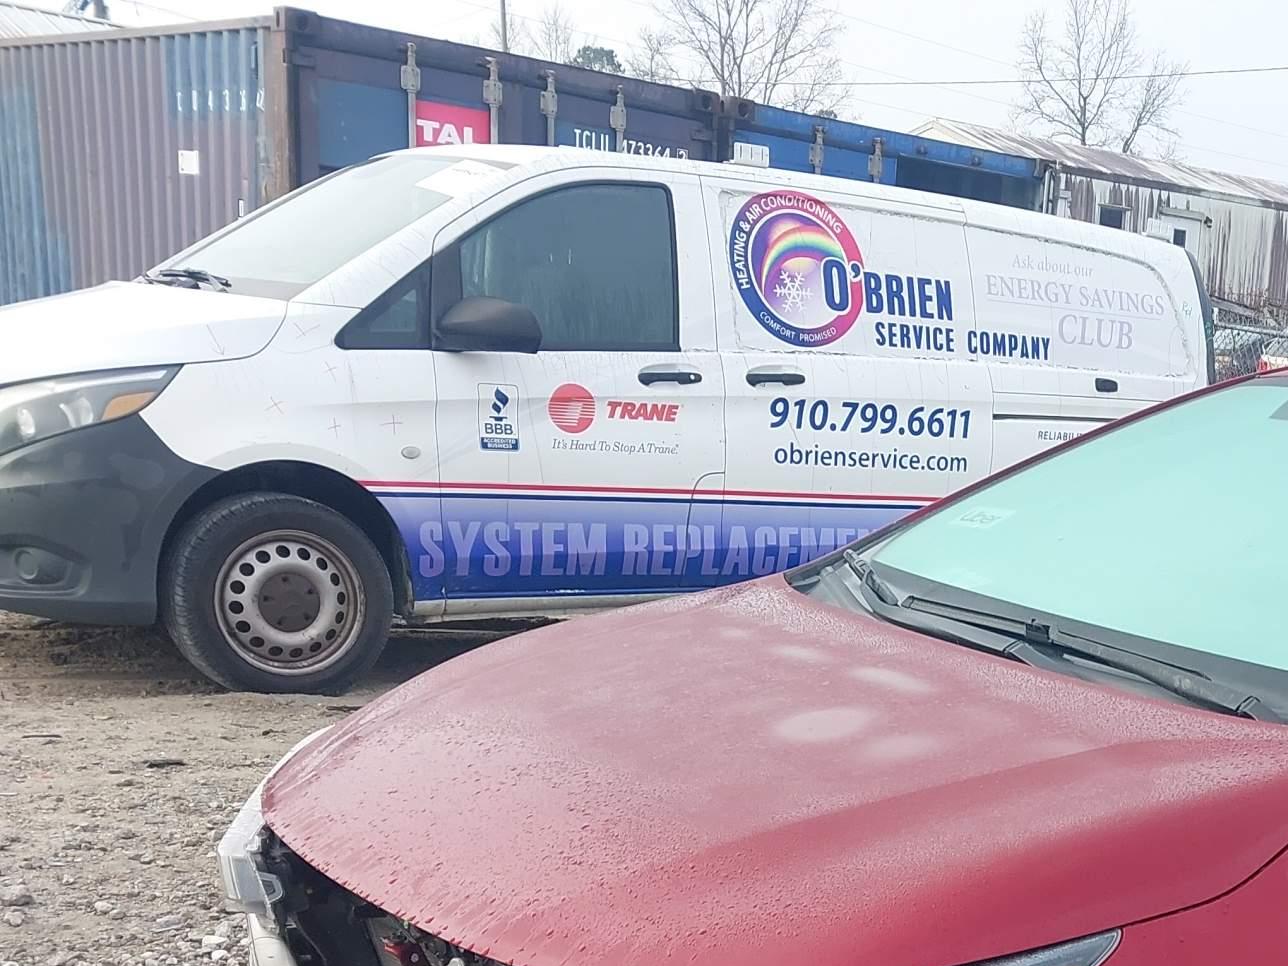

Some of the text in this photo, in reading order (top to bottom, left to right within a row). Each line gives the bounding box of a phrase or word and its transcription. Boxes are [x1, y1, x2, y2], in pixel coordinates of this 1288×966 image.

[734, 195, 843, 289] HEATING & AIR CONDITIONING
[1012, 255, 1093, 278] Ask about our
[822, 258, 954, 322] O'BRIEN
[985, 274, 1073, 305] ENERGY
[1079, 286, 1165, 316] SAVINGS
[759, 311, 837, 342] COMFORT PROMISED
[875, 322, 1050, 361] SERVICE COMPANY
[1058, 314, 1133, 350] CLUB
[484, 423, 513, 435] BBB
[607, 400, 680, 422] TRANE
[769, 397, 972, 439] 910.799.6611
[552, 438, 567, 449] It's
[569, 439, 597, 451] Hard
[599, 440, 611, 452] To
[612, 441, 636, 455] Stop
[637, 442, 646, 453] A
[774, 443, 968, 472] obrienservice.com
[419, 521, 606, 577] SYSTEM
